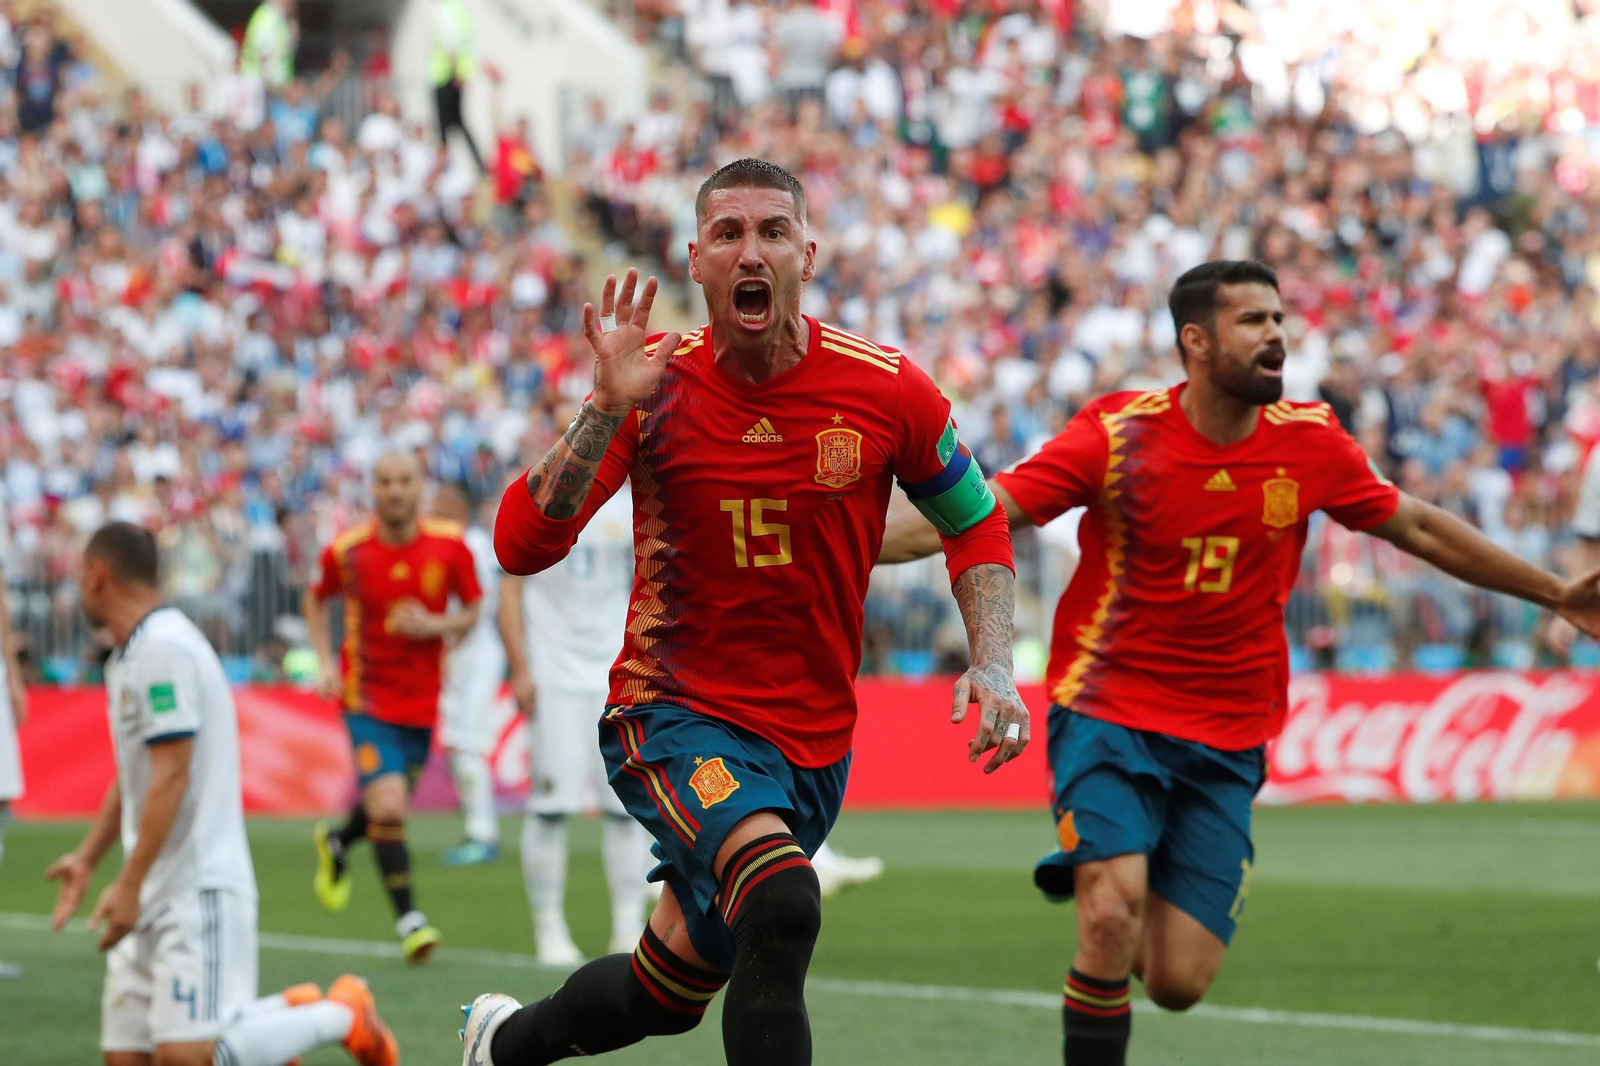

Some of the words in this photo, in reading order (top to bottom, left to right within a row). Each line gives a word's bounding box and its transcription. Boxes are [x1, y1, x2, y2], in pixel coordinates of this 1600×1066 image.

[742, 433, 783, 443] adidas
[720, 498, 793, 568] 15
[1181, 536, 1240, 593] 19
[172, 976, 197, 1020] 4
